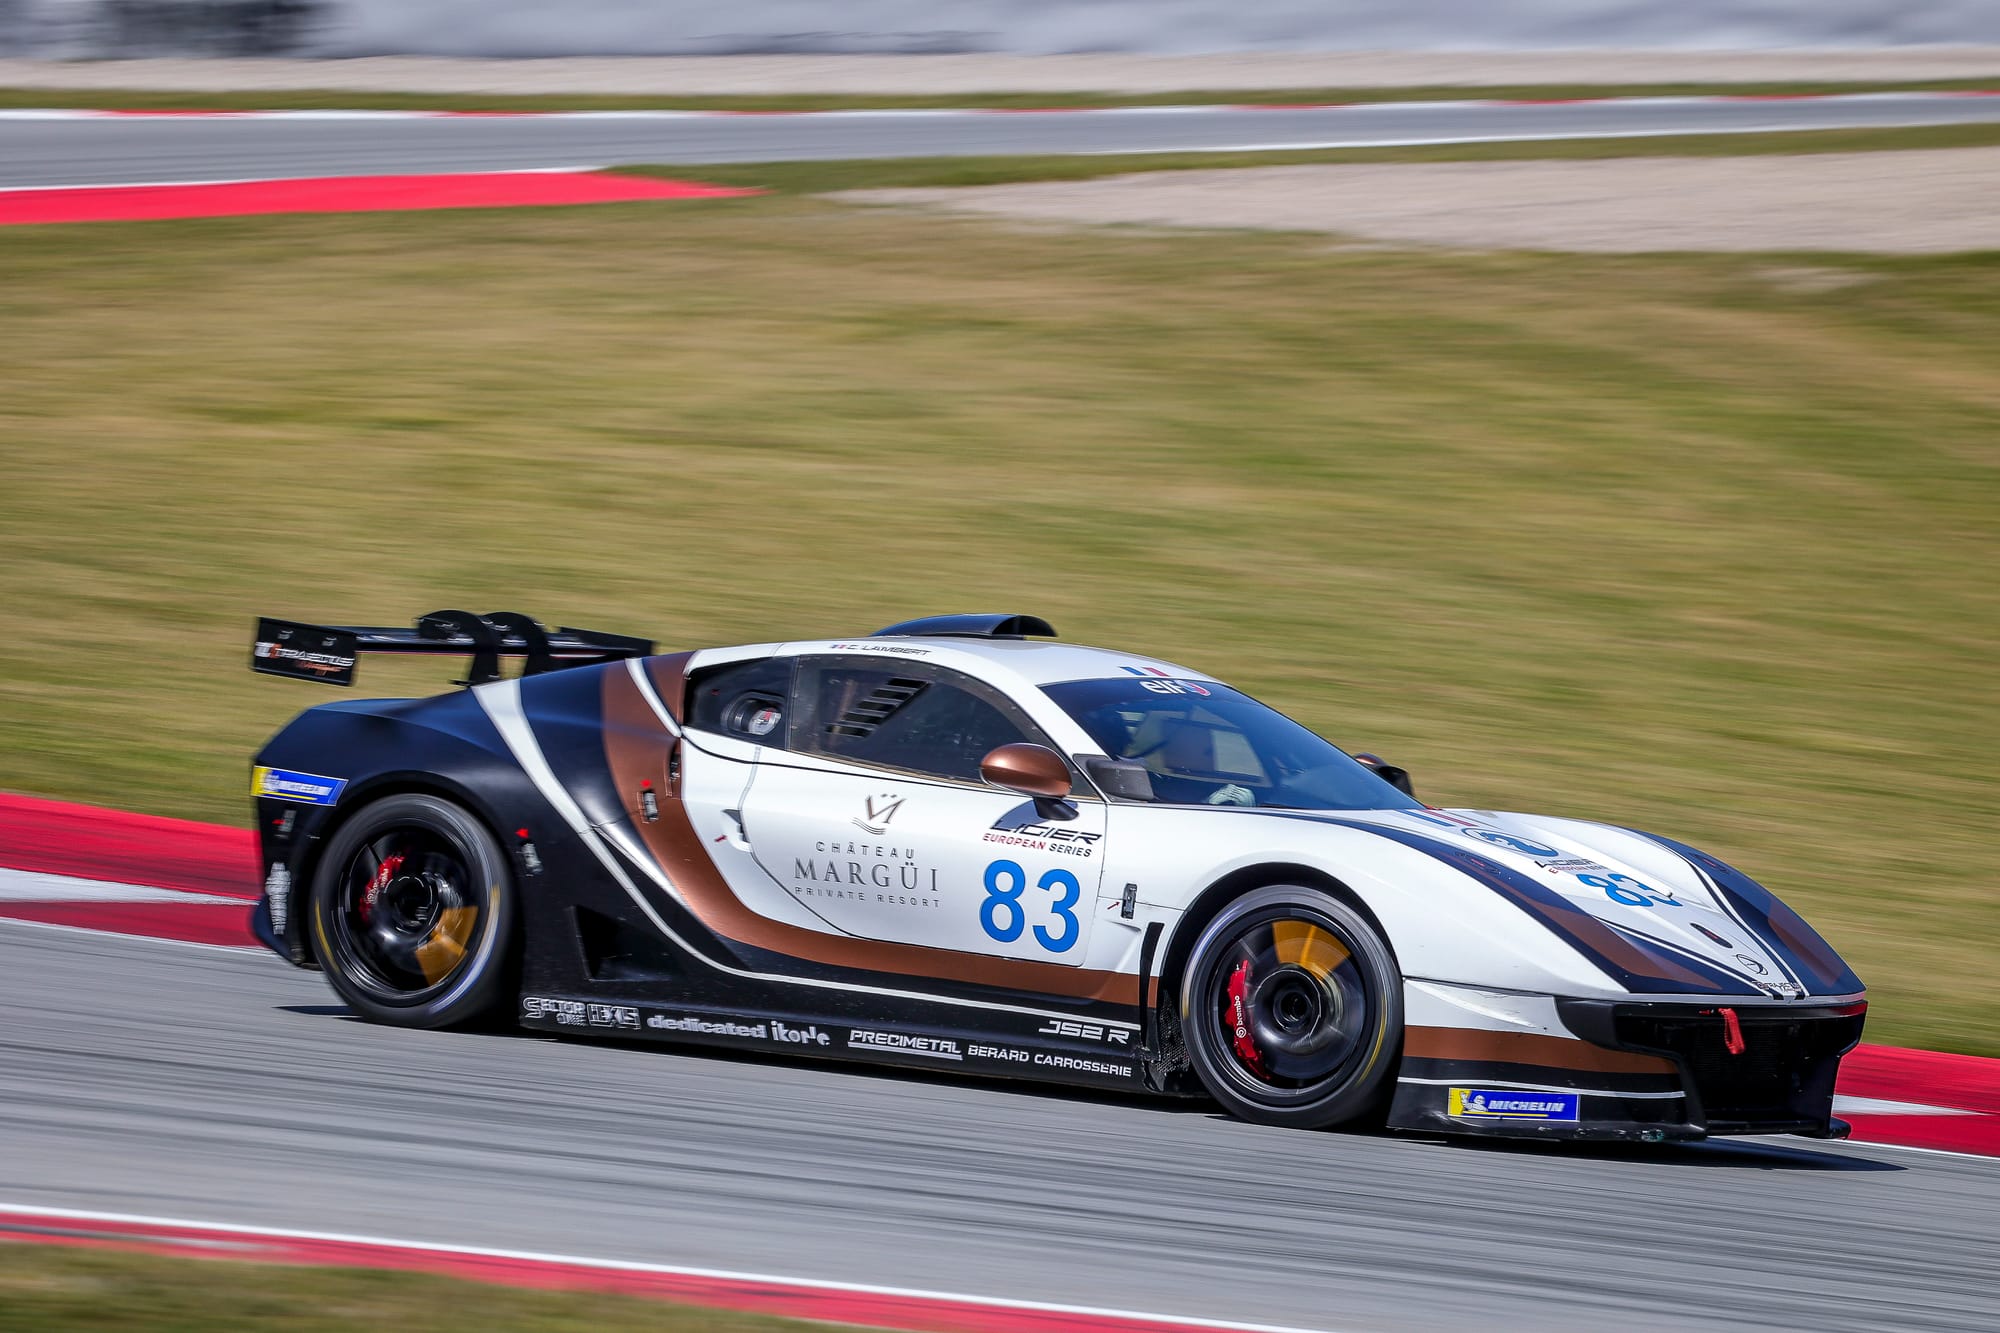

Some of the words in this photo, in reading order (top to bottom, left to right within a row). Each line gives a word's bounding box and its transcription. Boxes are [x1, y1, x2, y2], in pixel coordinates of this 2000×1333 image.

[862, 645, 932, 655] LAMBERT
[1139, 680, 1187, 694] elf
[989, 819, 1102, 845] LIGIER
[815, 841, 915, 859] CHÂTEAU
[982, 833, 1047, 850] EUROPEAN
[1049, 843, 1092, 858] SERIES
[794, 857, 939, 892] MARGÜI
[794, 887, 866, 901] PRIVATE
[877, 894, 940, 909] RESORT
[1576, 873, 1683, 907] 83
[979, 859, 1081, 953] 83
[1234, 995, 1244, 1026] brembo
[647, 1015, 768, 1039] dedicated
[1038, 1021, 1103, 1041] JS2
[1107, 1029, 1130, 1045] R
[850, 1029, 962, 1054] PRECIMETAL
[967, 1045, 1030, 1063] BERARD
[1034, 1053, 1132, 1078] CARROSSERIE
[1487, 1100, 1566, 1112] MICHELIN
